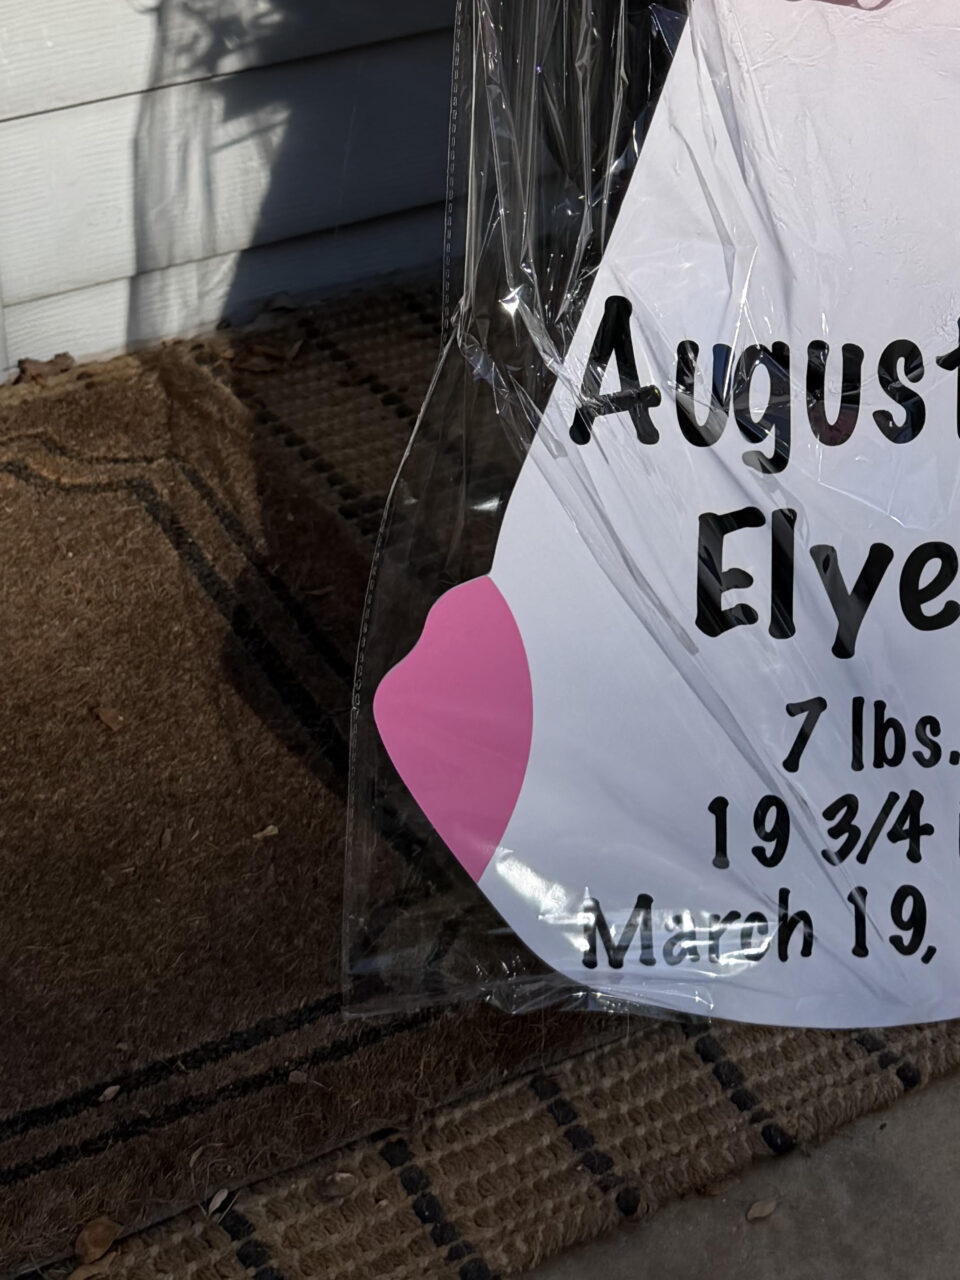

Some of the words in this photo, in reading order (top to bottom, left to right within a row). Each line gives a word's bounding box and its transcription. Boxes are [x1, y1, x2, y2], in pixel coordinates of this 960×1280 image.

[782, 696, 828, 773] 7
[850, 696, 960, 773] lbs.
[707, 794, 791, 869] 19
[821, 789, 935, 866] 3/4
[581, 887, 814, 969] March
[848, 884, 937, 965] 19,
